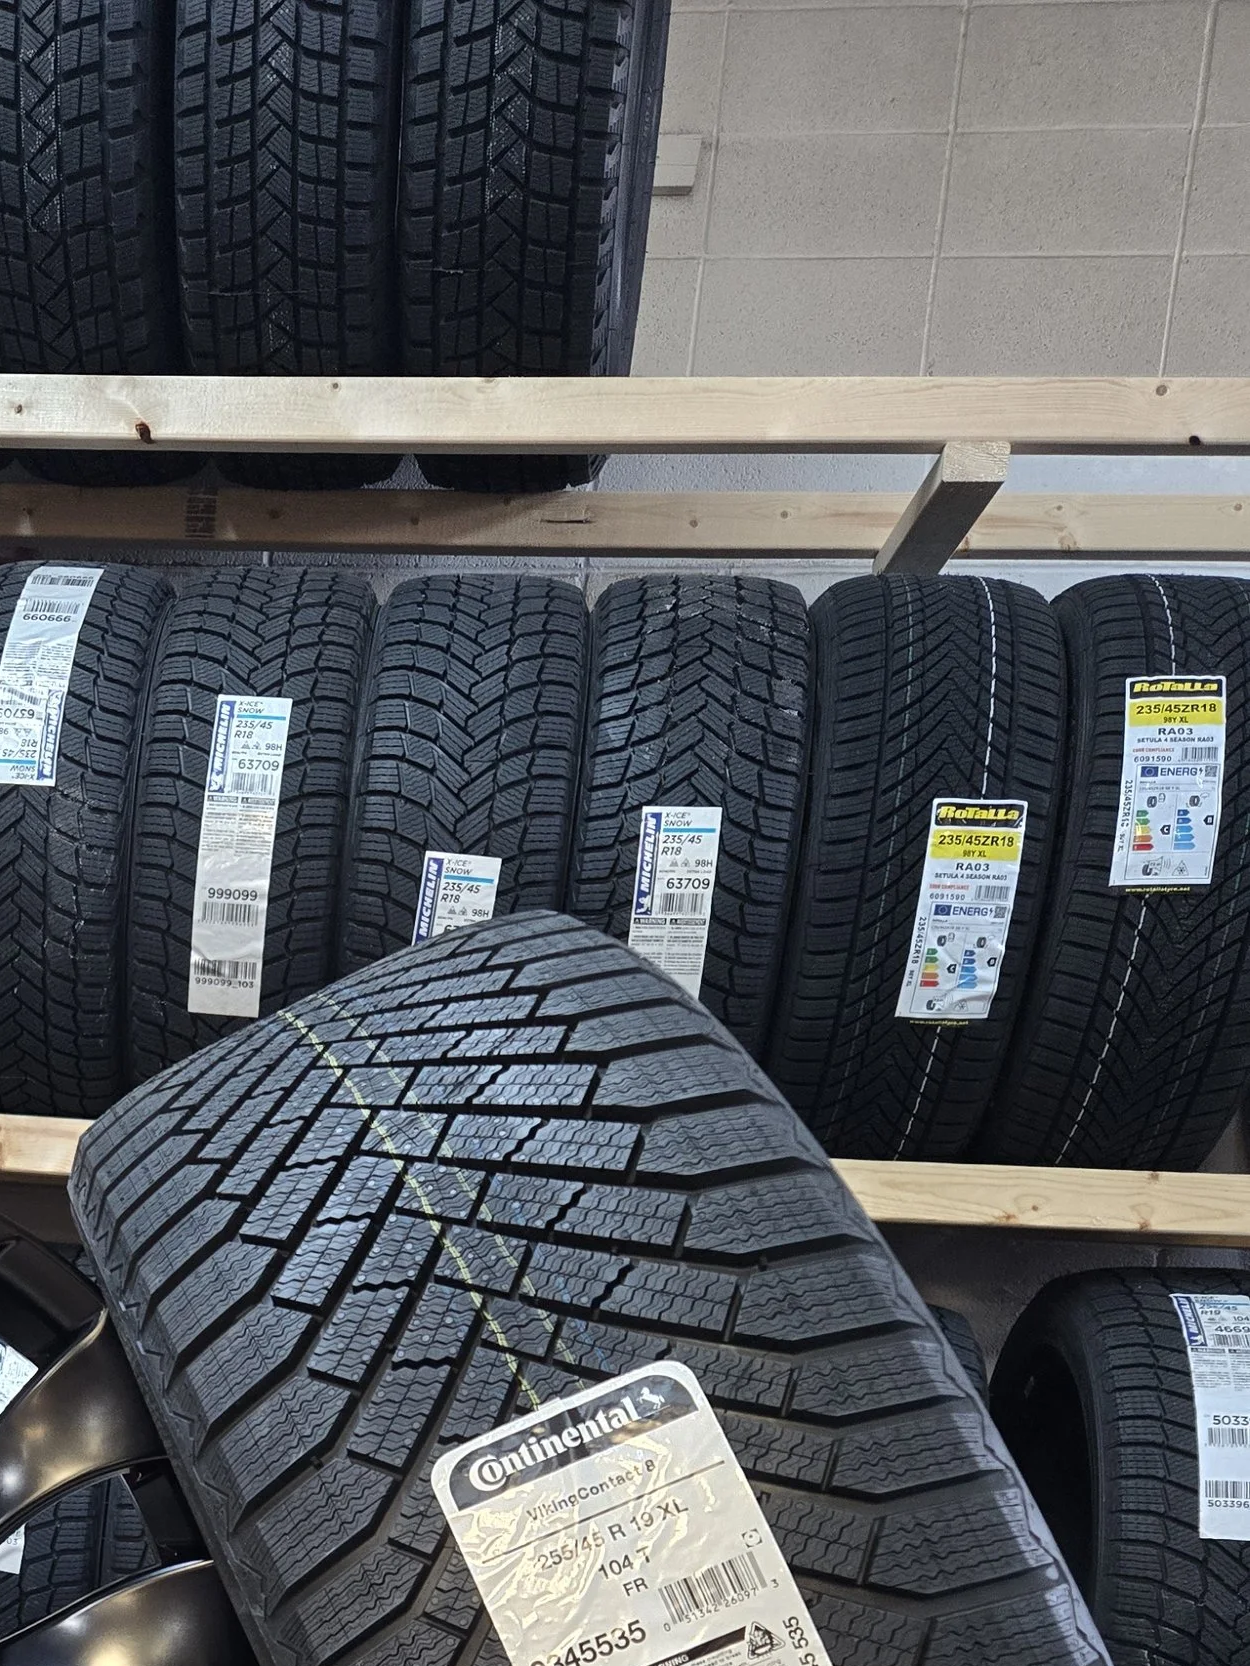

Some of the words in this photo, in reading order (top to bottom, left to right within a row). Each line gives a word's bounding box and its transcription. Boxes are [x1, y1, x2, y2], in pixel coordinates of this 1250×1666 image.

[1136, 703, 1217, 715] 235/45ZR18
[235, 719, 274, 730] 235/45
[213, 703, 232, 771] MICHELIN
[234, 730, 254, 739] R18
[1157, 727, 1194, 736] RA03
[265, 743, 283, 751] 98H
[1, 748, 38, 759] 235/45
[1133, 755, 1172, 763] 6091590
[9, 764, 36, 773] SNOW
[238, 758, 280, 772] 63709
[1159, 767, 1198, 777] ENERG
[663, 819, 692, 827] SNOW
[662, 834, 703, 845] 235/45
[938, 834, 1015, 848] 235/45ZR18
[640, 814, 658, 893] MICHELIN
[661, 846, 683, 856] R18
[978, 850, 987, 858] XL
[694, 859, 714, 868] 98H
[955, 862, 990, 872] RA03
[444, 866, 473, 876] SNOW
[442, 881, 482, 894] 235/45
[666, 877, 711, 890] 63709
[207, 887, 258, 901] 999099
[418, 860, 439, 938] MICHELIN
[440, 893, 461, 904] R18
[929, 892, 966, 901] 6091590
[471, 909, 490, 918] 98H
[952, 906, 988, 916] ENERG
[194, 977, 255, 989] 999099_103
[468, 1396, 642, 1492] Continental
[526, 1464, 643, 1522] VikingContact
[645, 1458, 657, 1472] 8
[538, 1536, 606, 1571] 255/45
[607, 1523, 627, 1542] R
[630, 1511, 655, 1532] 19
[656, 1498, 690, 1521] XL
[598, 1555, 634, 1581] 104
[636, 1545, 651, 1564] T
[622, 1577, 650, 1597] FR
[684, 1604, 721, 1625] 51342
[724, 1587, 759, 1609] 26097
[771, 1578, 780, 1589] 3
[782, 1615, 810, 1651] 535
